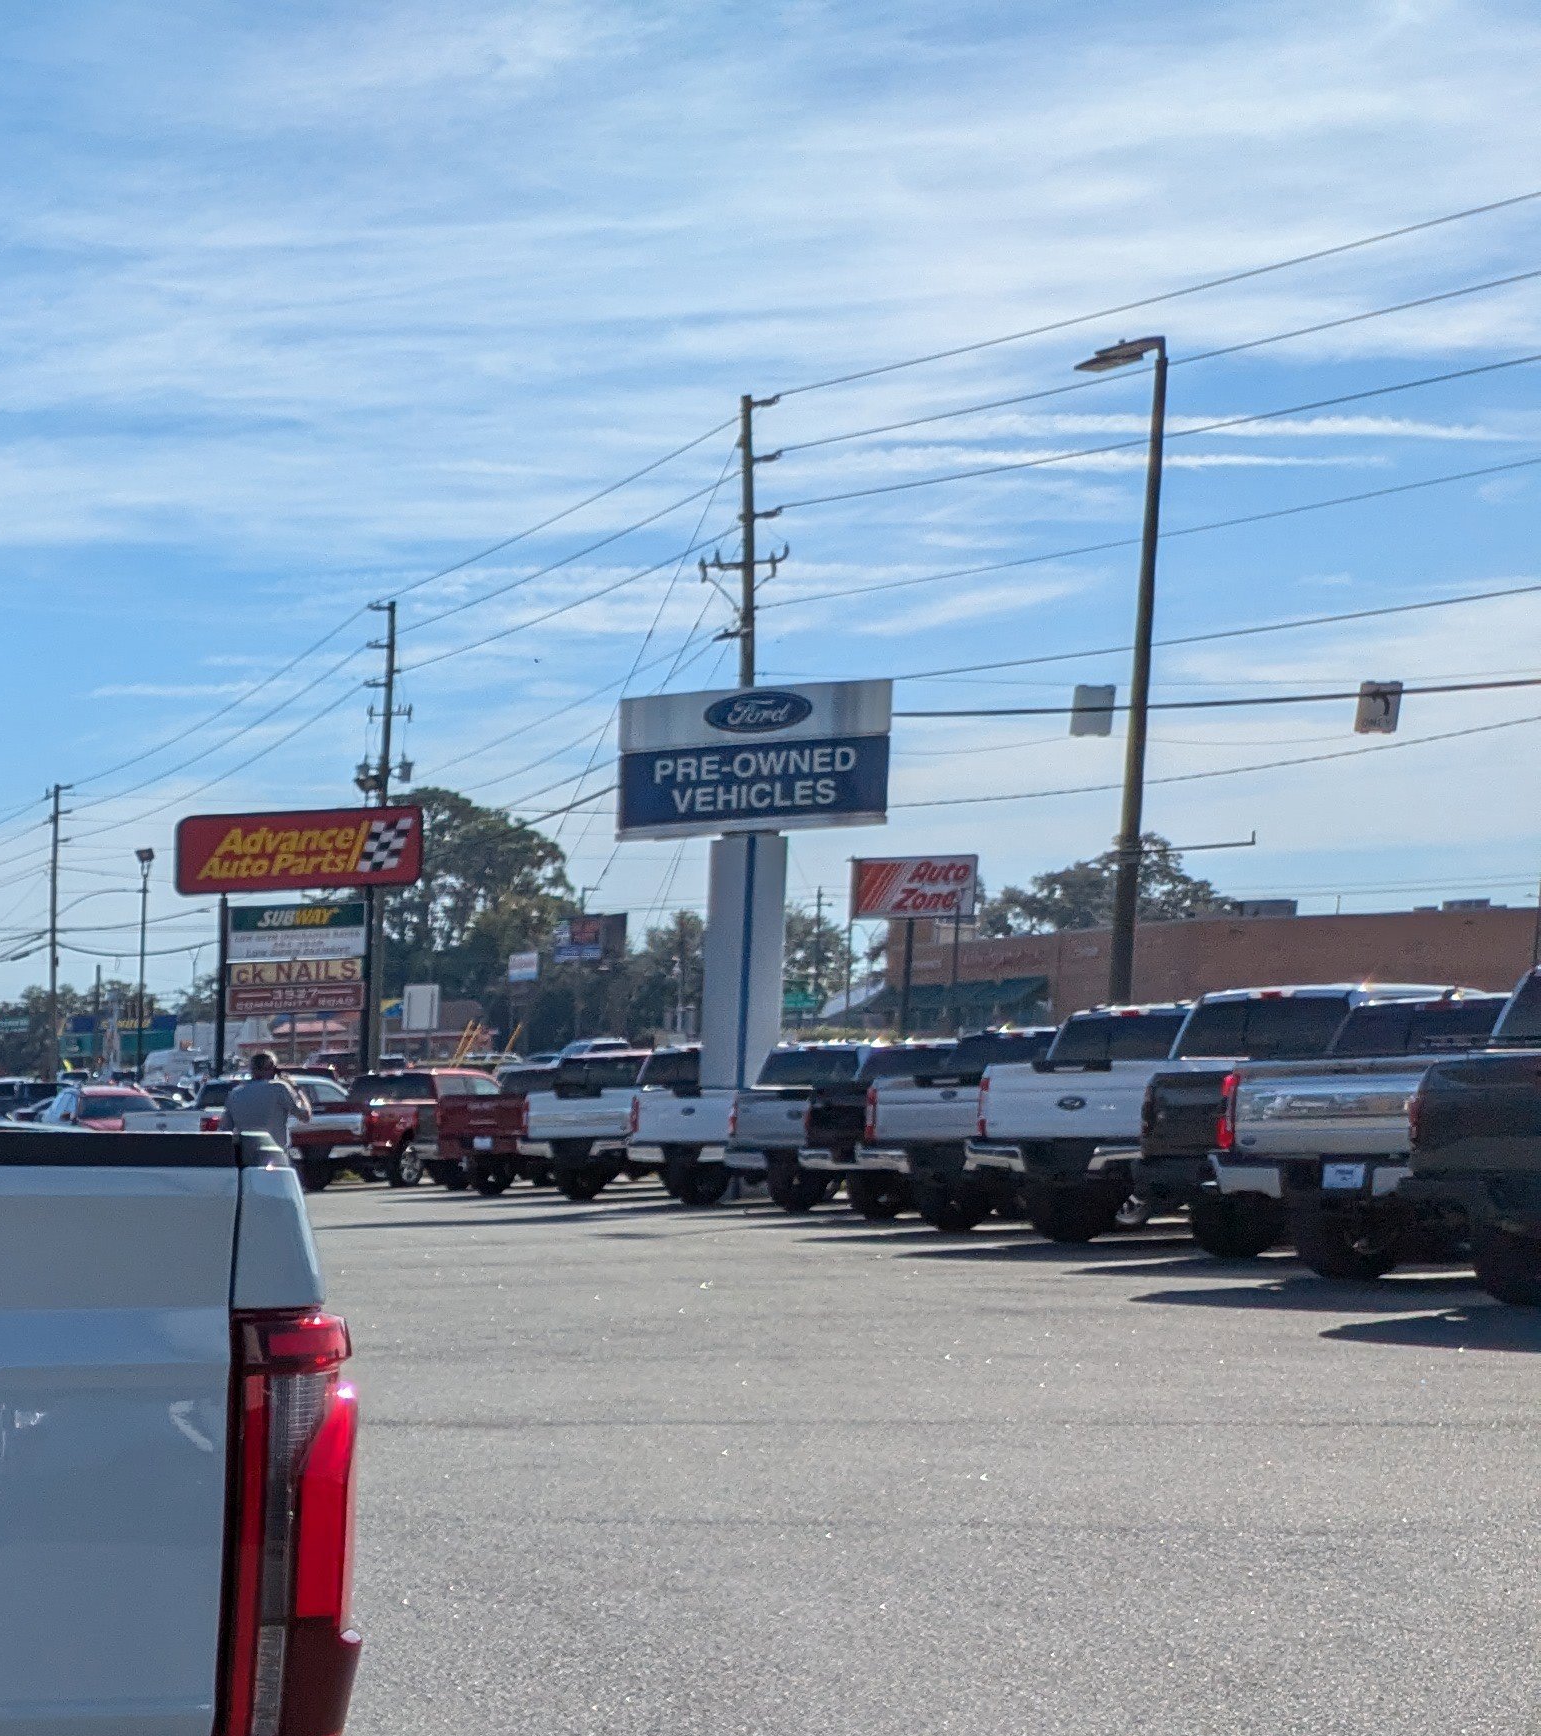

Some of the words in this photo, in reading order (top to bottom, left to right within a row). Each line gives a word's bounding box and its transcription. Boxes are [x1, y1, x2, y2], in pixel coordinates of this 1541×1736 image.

[727, 699, 790, 725] Ford
[654, 747, 856, 785] PRE-OWNED
[671, 778, 836, 813] VEHICLES
[216, 827, 356, 855] Advance
[197, 855, 271, 880] Auto
[270, 850, 349, 877] Parts
[907, 861, 971, 883] Auto
[891, 888, 958, 912] Zone
[258, 908, 339, 928] SUBWAY
[275, 959, 357, 981] NAILS
